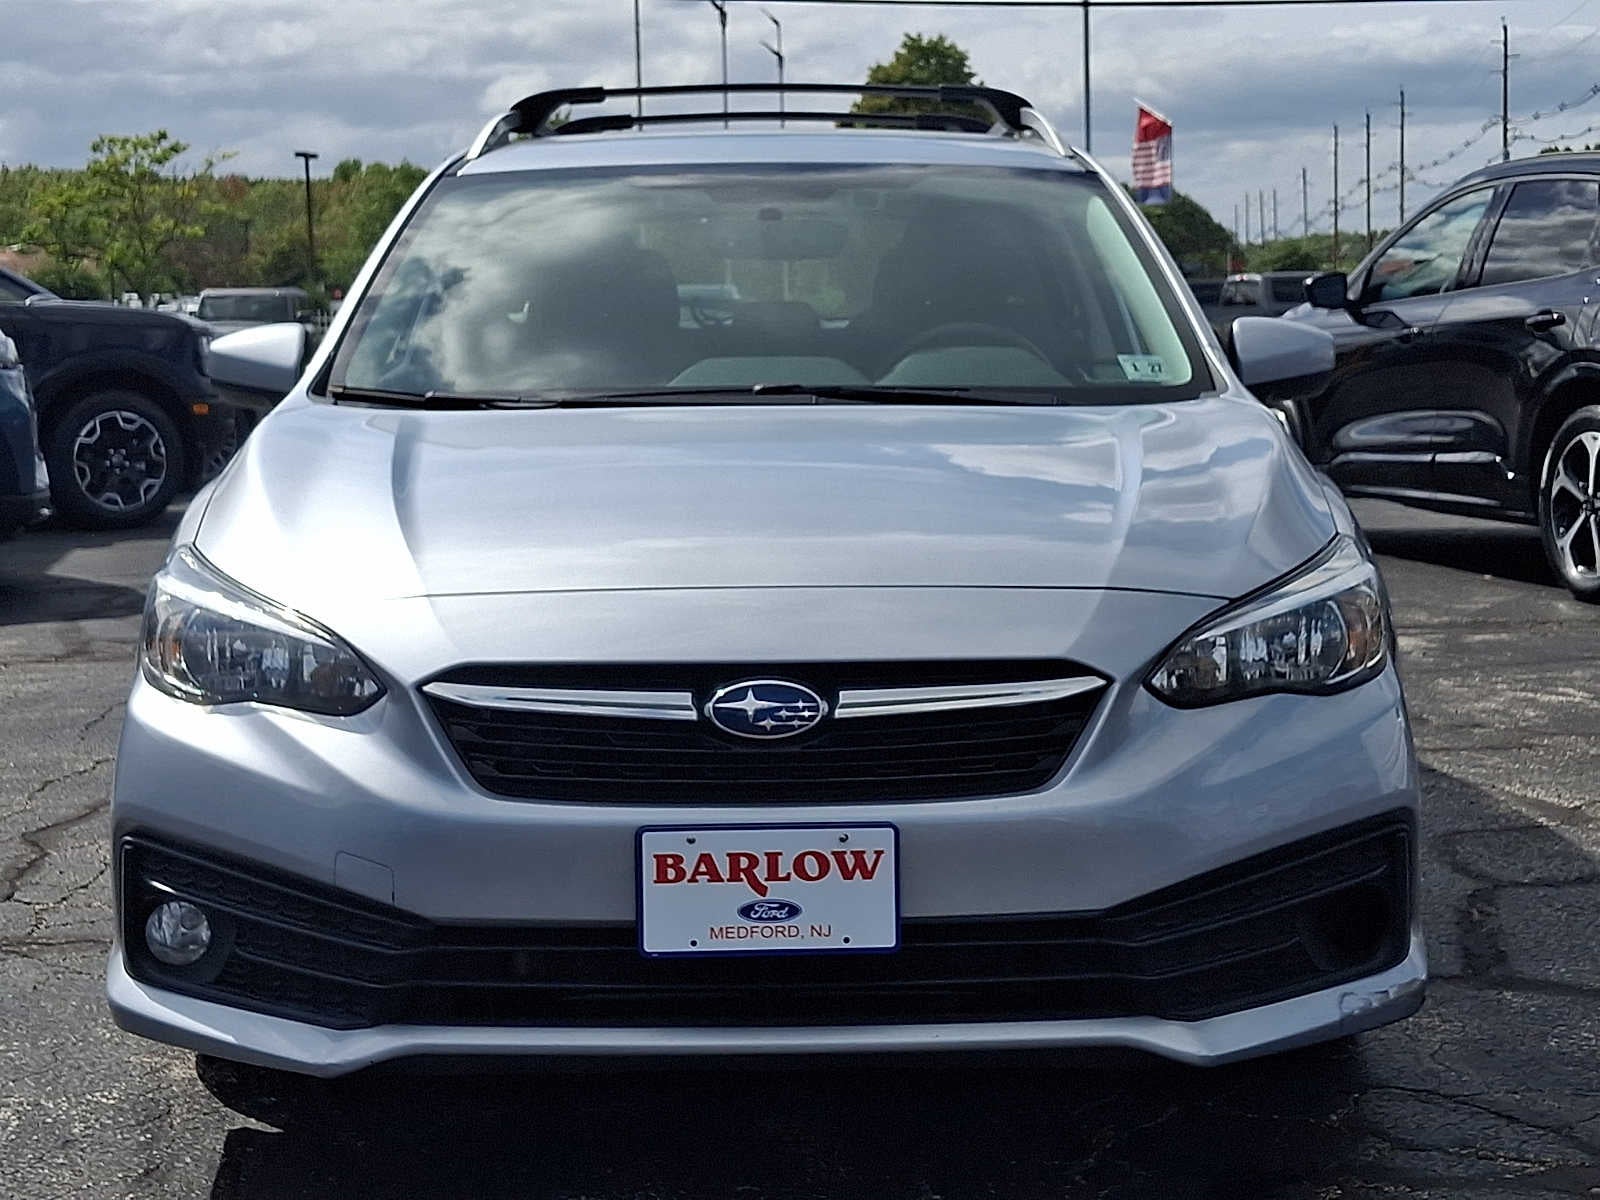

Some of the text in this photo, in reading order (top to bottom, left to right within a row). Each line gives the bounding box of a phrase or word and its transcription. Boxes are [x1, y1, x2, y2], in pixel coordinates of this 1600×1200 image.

[653, 850, 885, 897] BARLOW
[749, 902, 790, 919] Ford
[709, 924, 832, 940] MEDFORD, NJ
